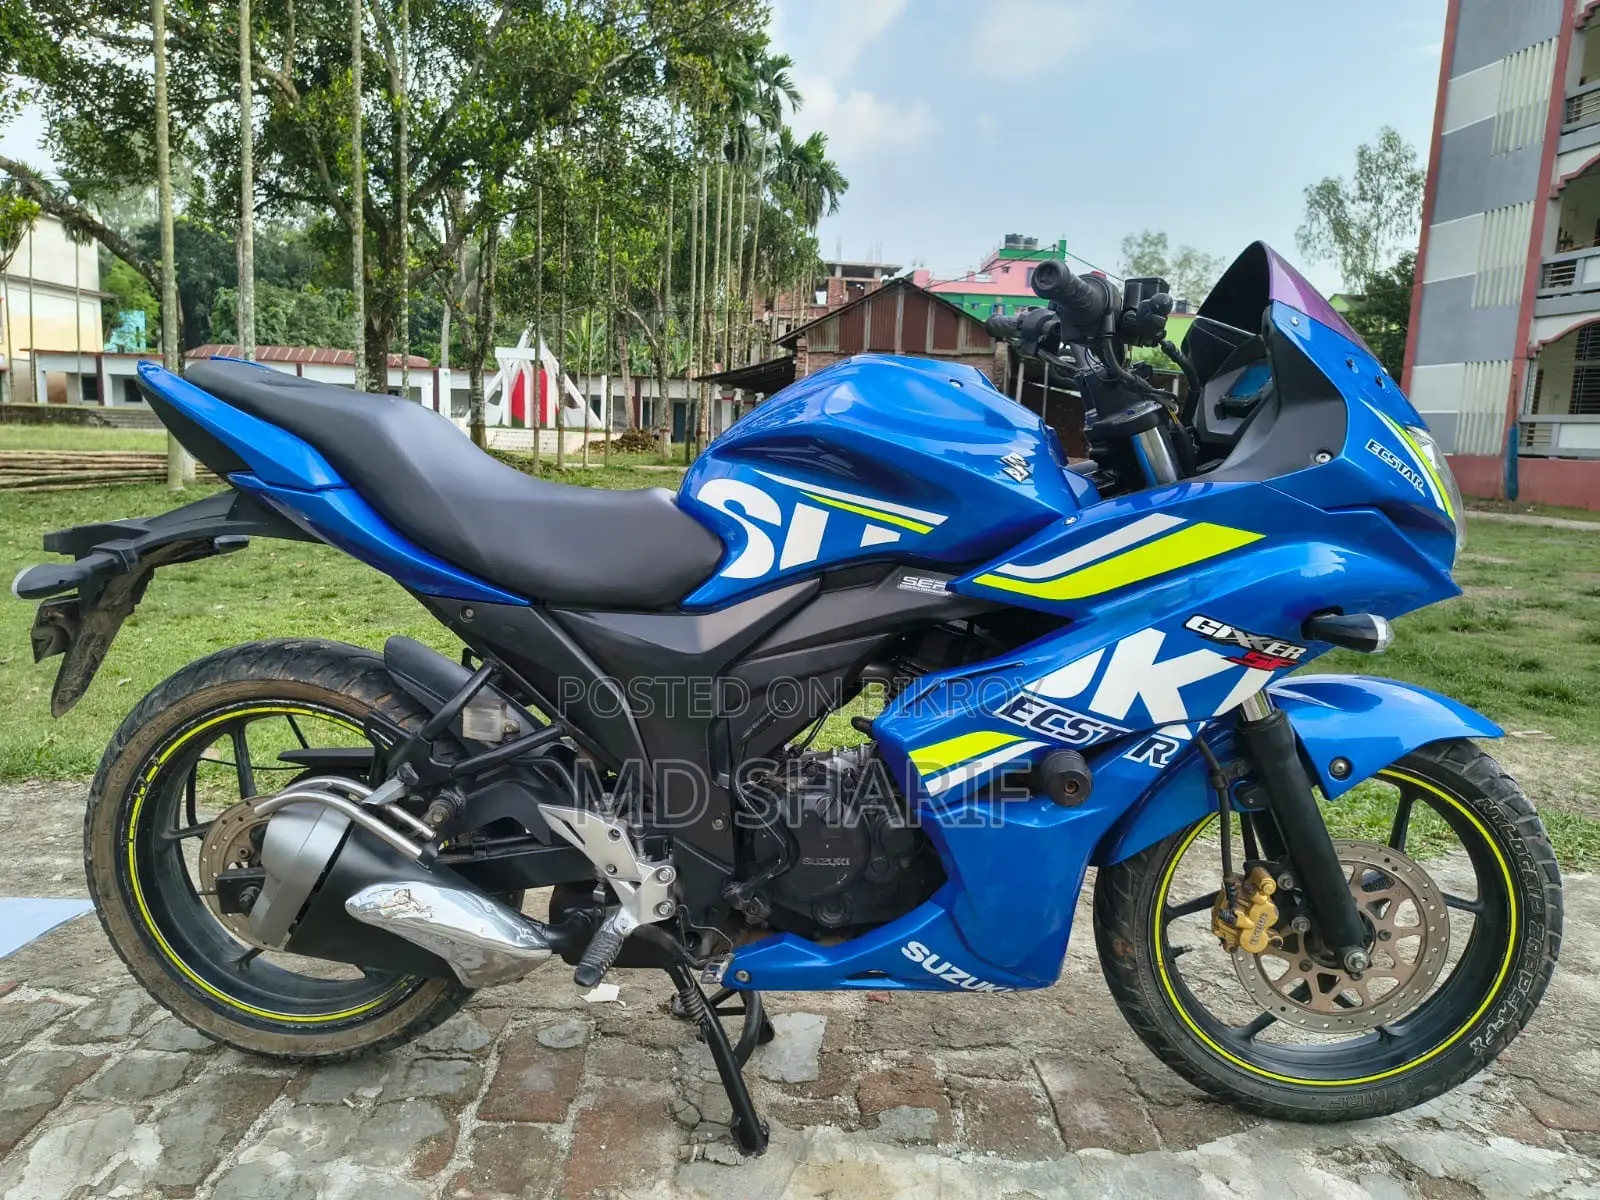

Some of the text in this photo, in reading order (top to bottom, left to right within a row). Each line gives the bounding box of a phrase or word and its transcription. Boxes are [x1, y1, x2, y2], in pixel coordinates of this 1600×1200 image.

[1364, 438, 1426, 498] ECSTAR
[1185, 614, 1307, 660] GIXXER
[993, 691, 1180, 769] ECSTR
